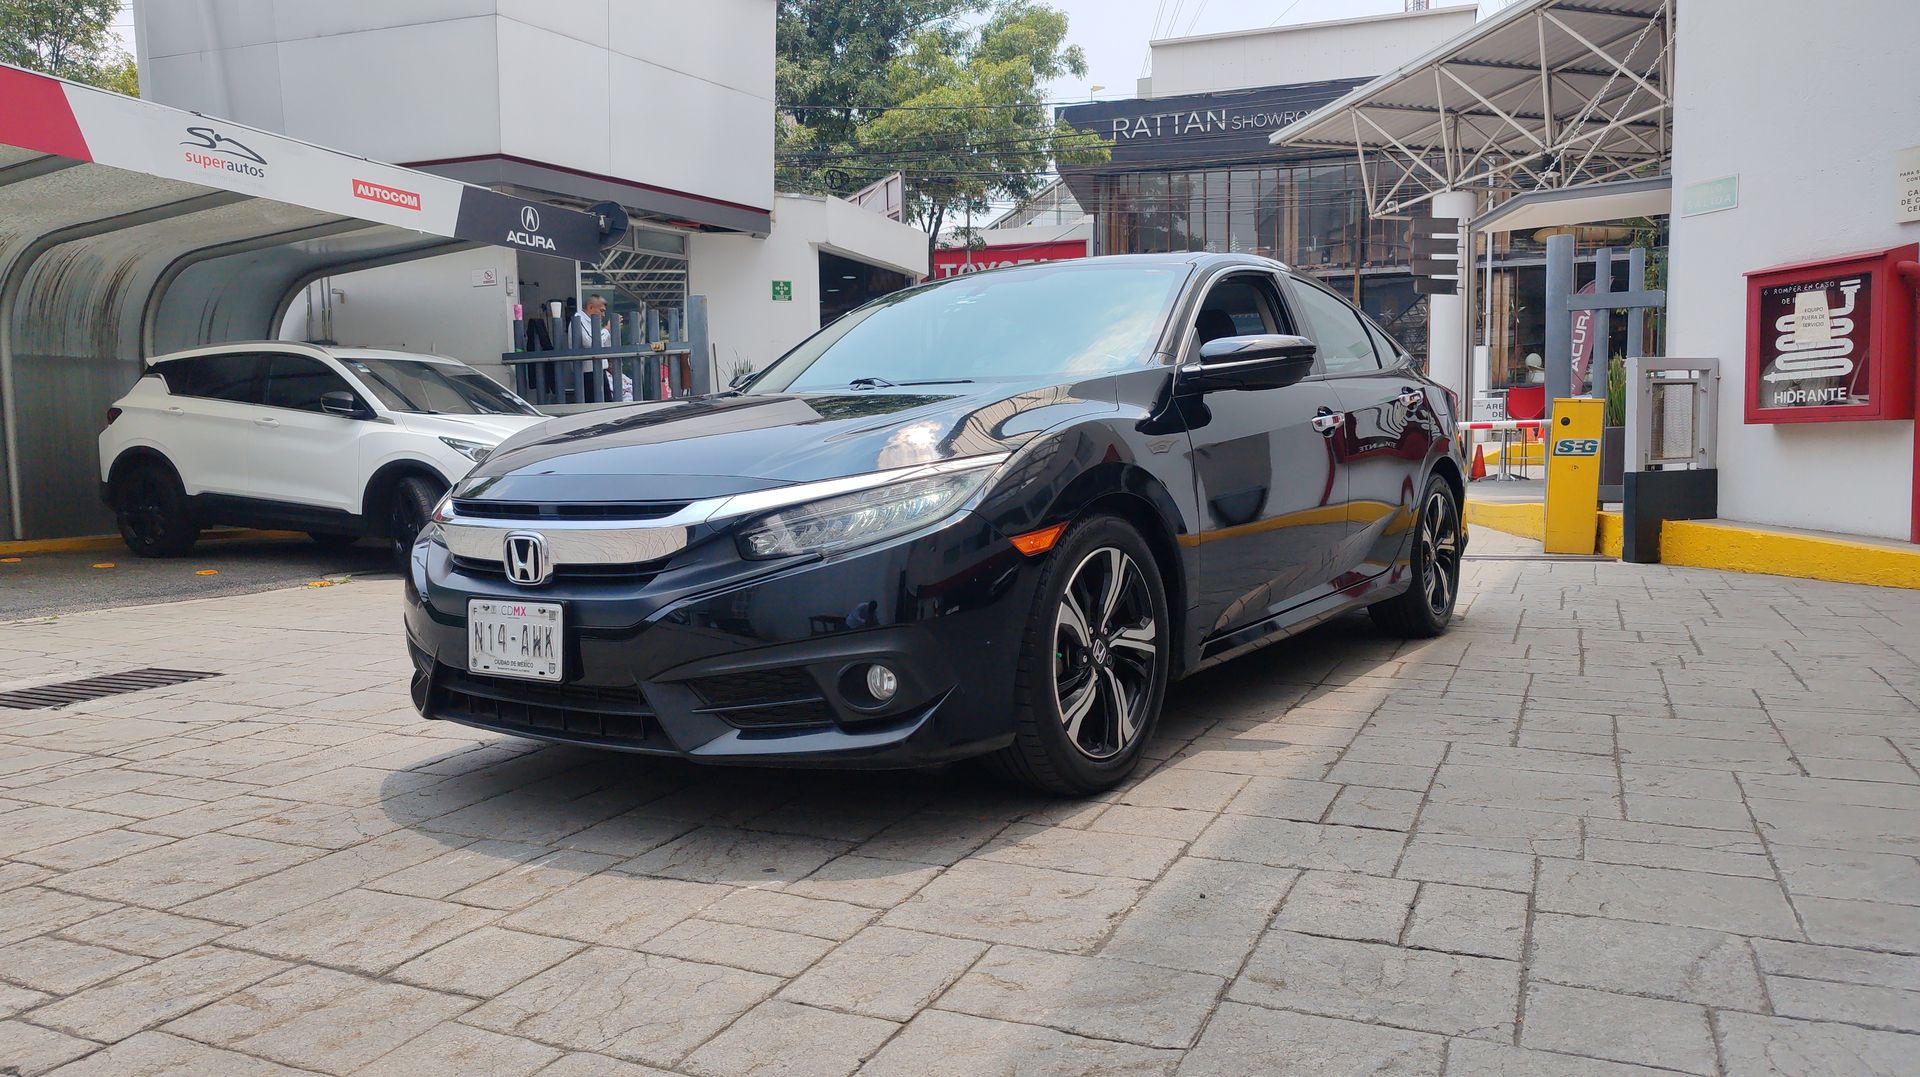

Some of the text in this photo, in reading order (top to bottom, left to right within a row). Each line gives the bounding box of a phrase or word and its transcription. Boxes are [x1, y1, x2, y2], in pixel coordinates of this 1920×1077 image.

[1113, 109, 1314, 140] RATTAN SHOWRO
[185, 152, 265, 178] superautos
[357, 184, 418, 207] AUTOCOM
[506, 230, 556, 251] ACURA
[1773, 286, 1801, 295] ROMPER
[1815, 281, 1834, 289] CASO
[1774, 387, 1847, 404] HIDRANTE
[1557, 440, 1599, 453] SEG
[501, 606, 526, 616] CDMX
[475, 622, 553, 657] N14-AWK
